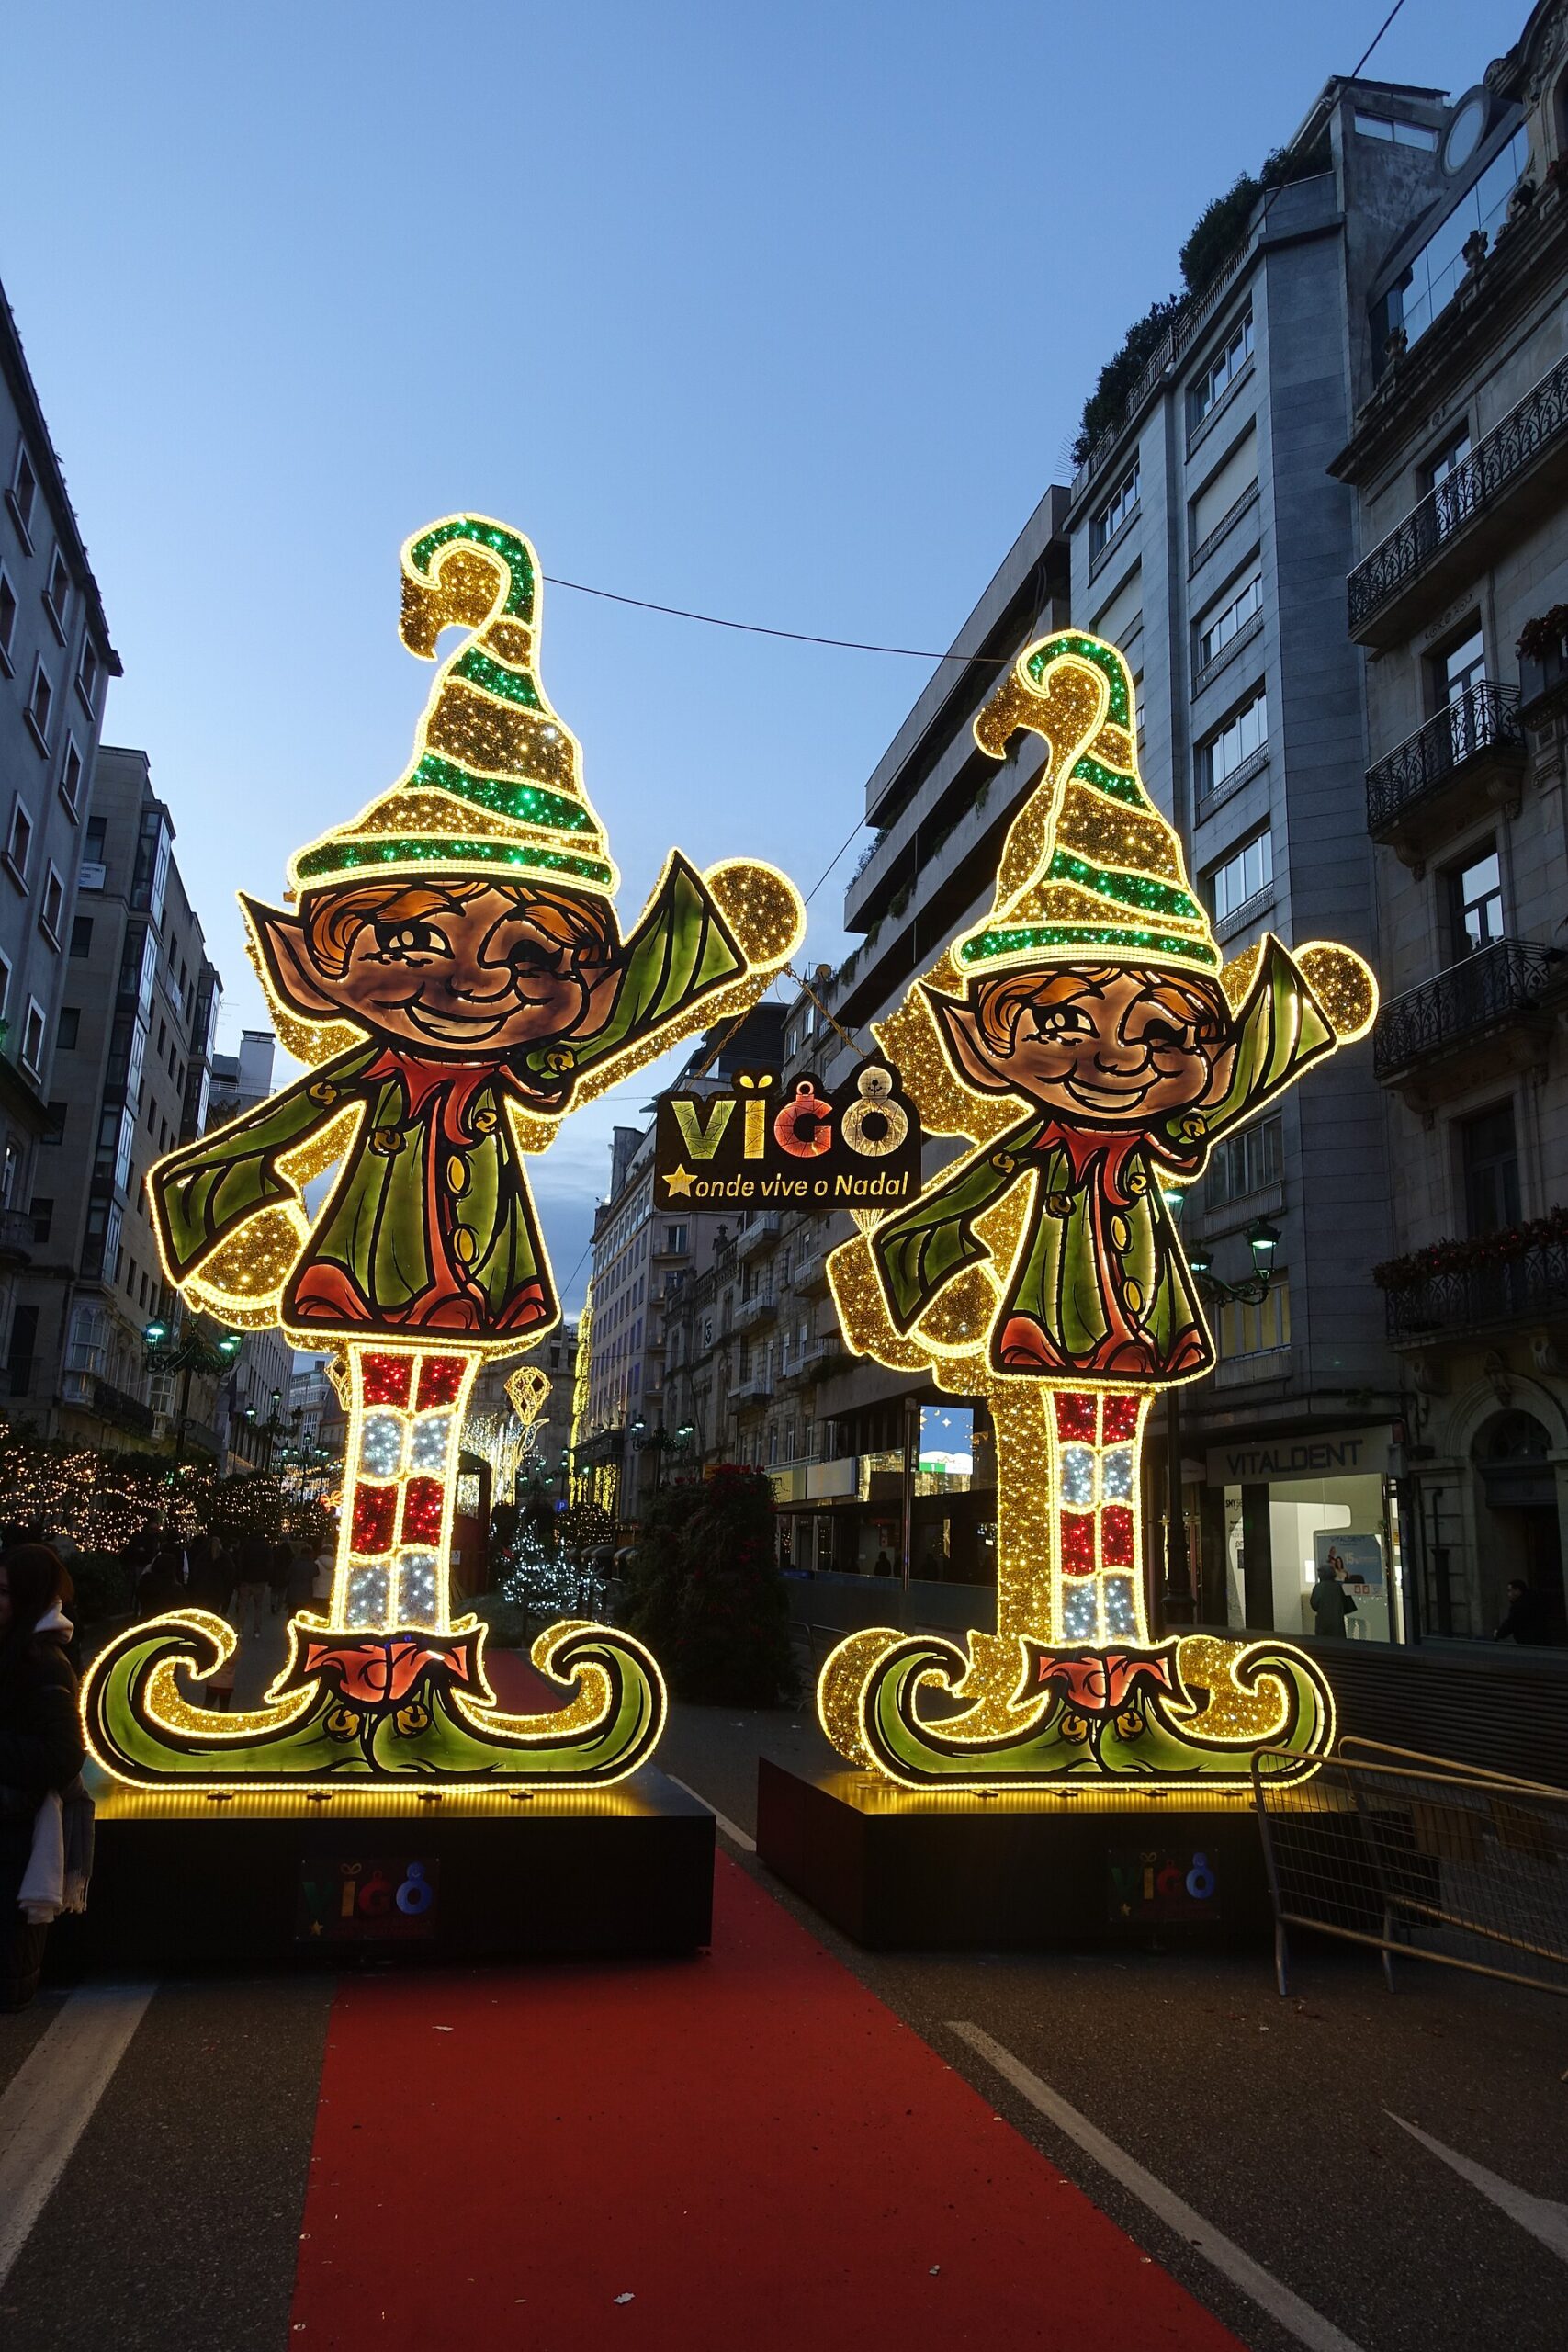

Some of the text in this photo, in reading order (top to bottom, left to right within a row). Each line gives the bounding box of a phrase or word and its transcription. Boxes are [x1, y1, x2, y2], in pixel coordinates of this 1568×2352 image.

[695, 1171, 909, 1197] onde vive o Nadal
[1226, 1439, 1363, 1476] VITALDENT
